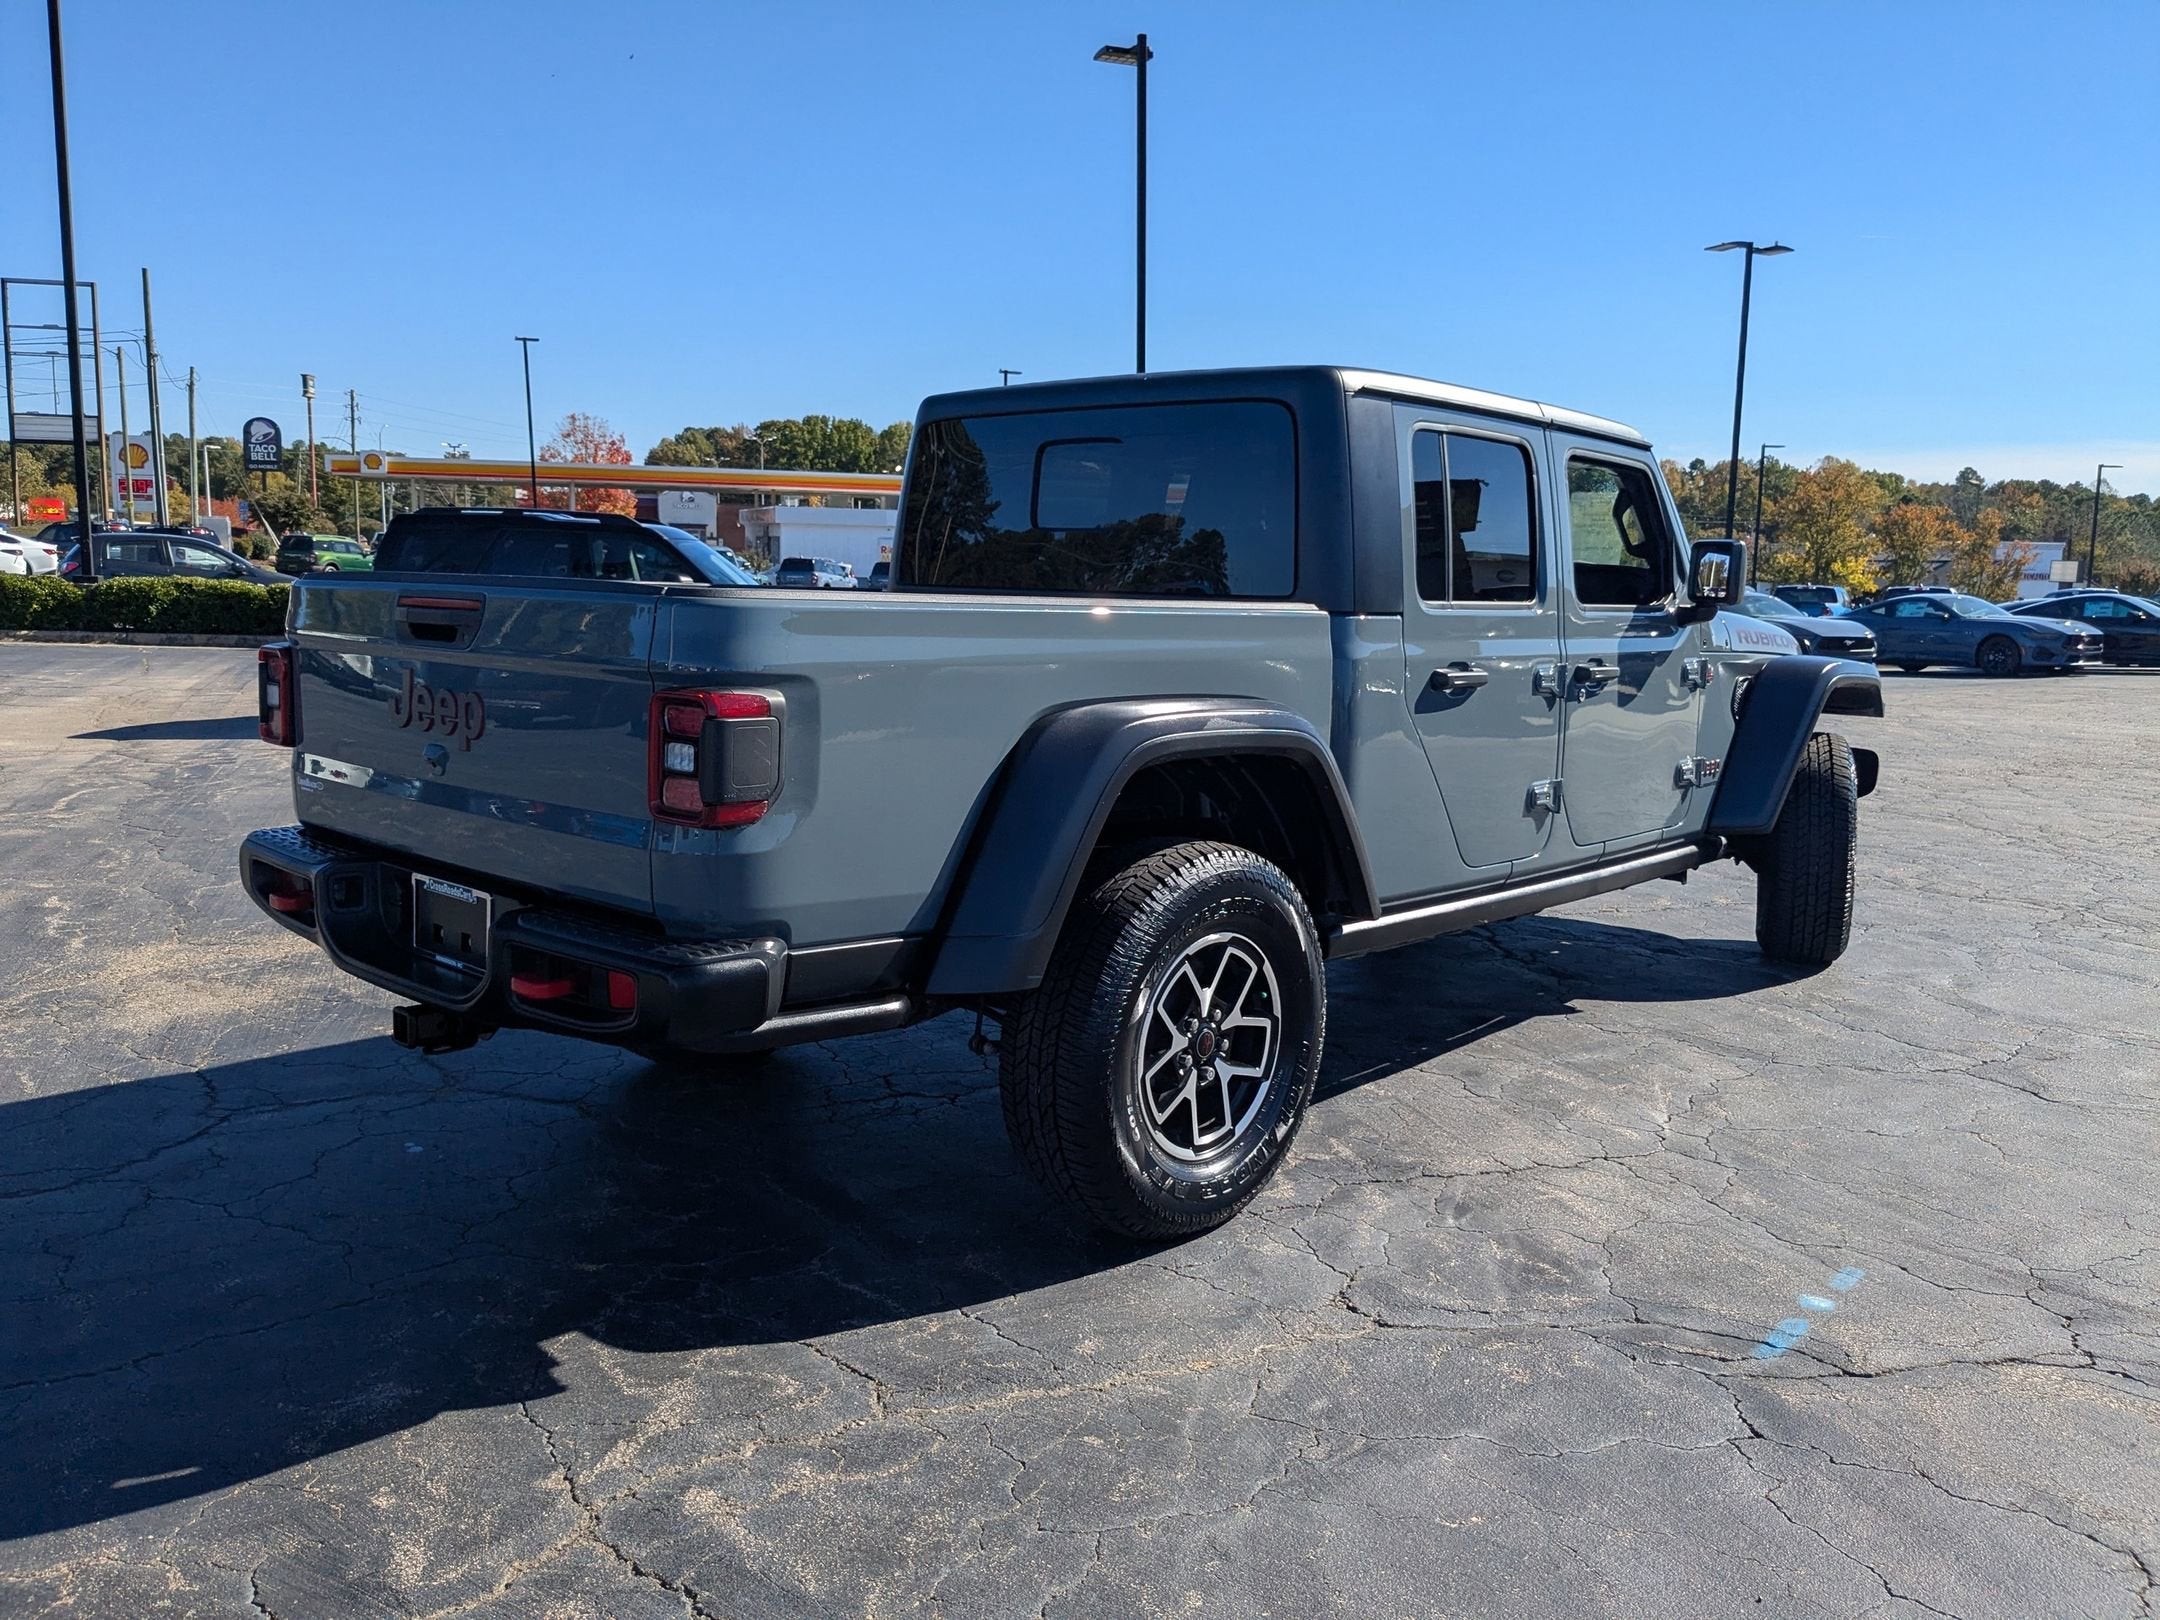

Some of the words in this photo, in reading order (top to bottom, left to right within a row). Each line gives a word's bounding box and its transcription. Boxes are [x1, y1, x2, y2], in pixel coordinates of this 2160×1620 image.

[248, 444, 277, 453] TACO
[250, 453, 277, 461] BELL
[387, 663, 485, 752] Jeep
